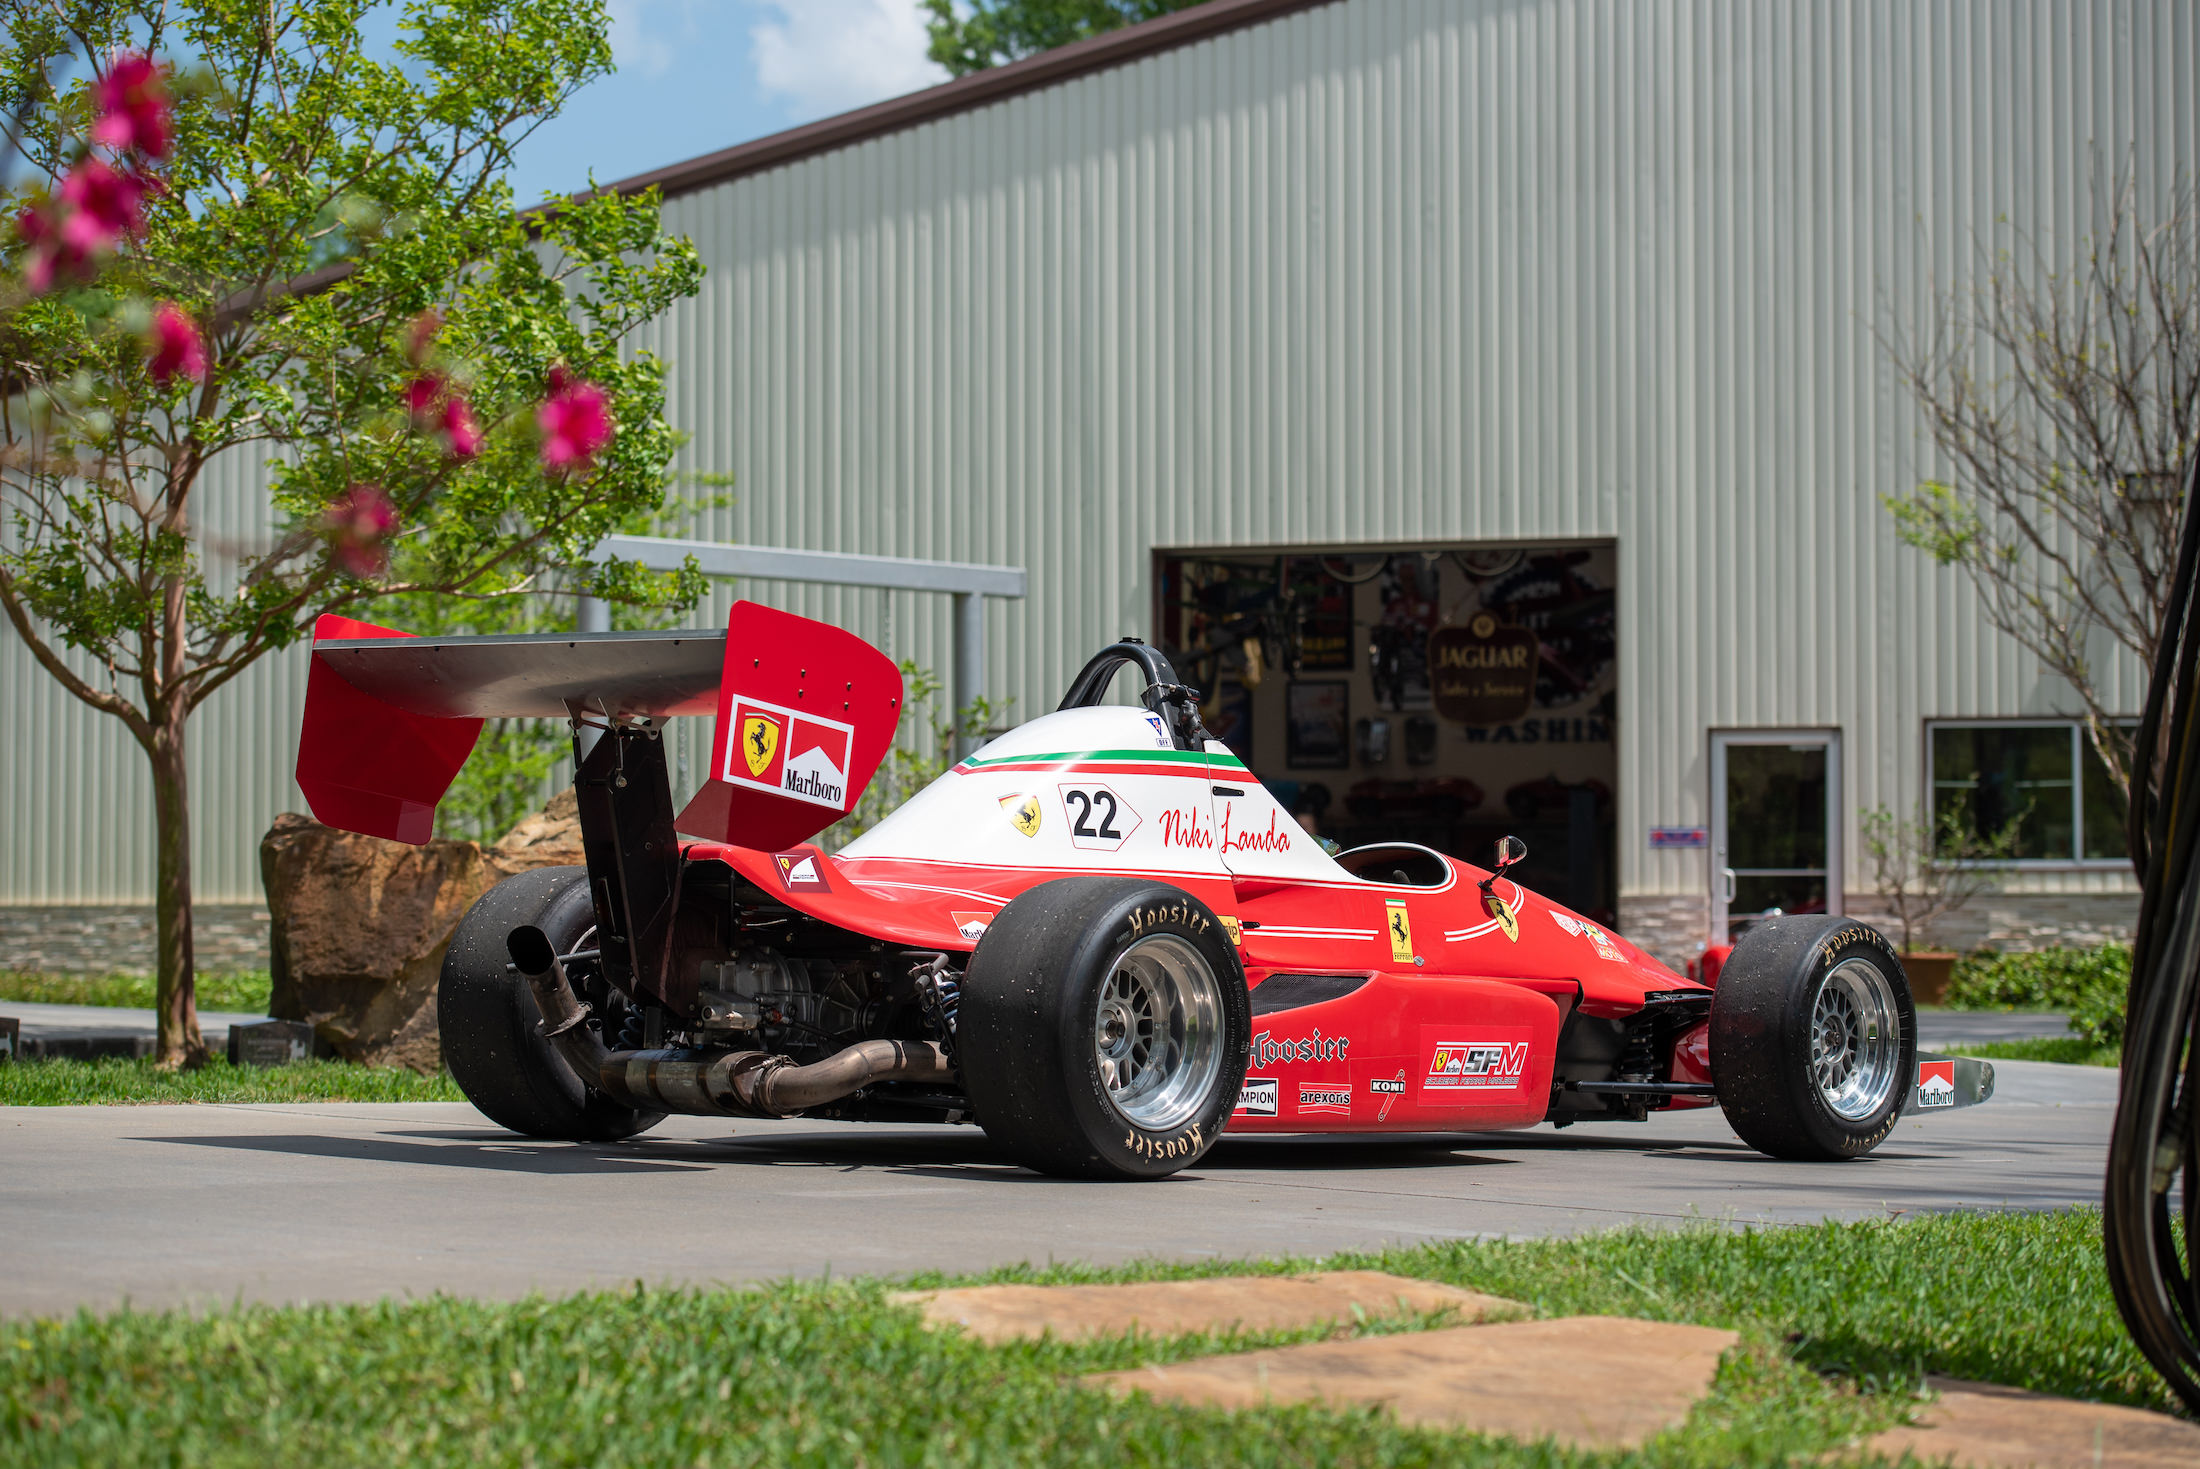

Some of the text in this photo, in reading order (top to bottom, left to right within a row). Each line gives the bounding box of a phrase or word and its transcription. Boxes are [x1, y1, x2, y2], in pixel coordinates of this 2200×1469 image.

[1438, 644, 1530, 669] JAGUAR
[785, 768, 842, 802] Marlboro
[1066, 790, 1121, 840] 22
[1159, 806, 1213, 849] Niki
[960, 928, 984, 939] Marl
[1128, 898, 1210, 941] Hoosier
[1816, 927, 1878, 967] Hoosier
[1246, 1027, 1350, 1070] Hoosier
[1462, 1042, 1529, 1075] SFM
[1238, 1091, 1274, 1104] MPION
[1299, 1091, 1351, 1105] arexons
[1372, 1081, 1404, 1092] KONI
[1919, 1087, 1953, 1106] Marlboro
[1124, 1122, 1204, 1165] Hoosier
